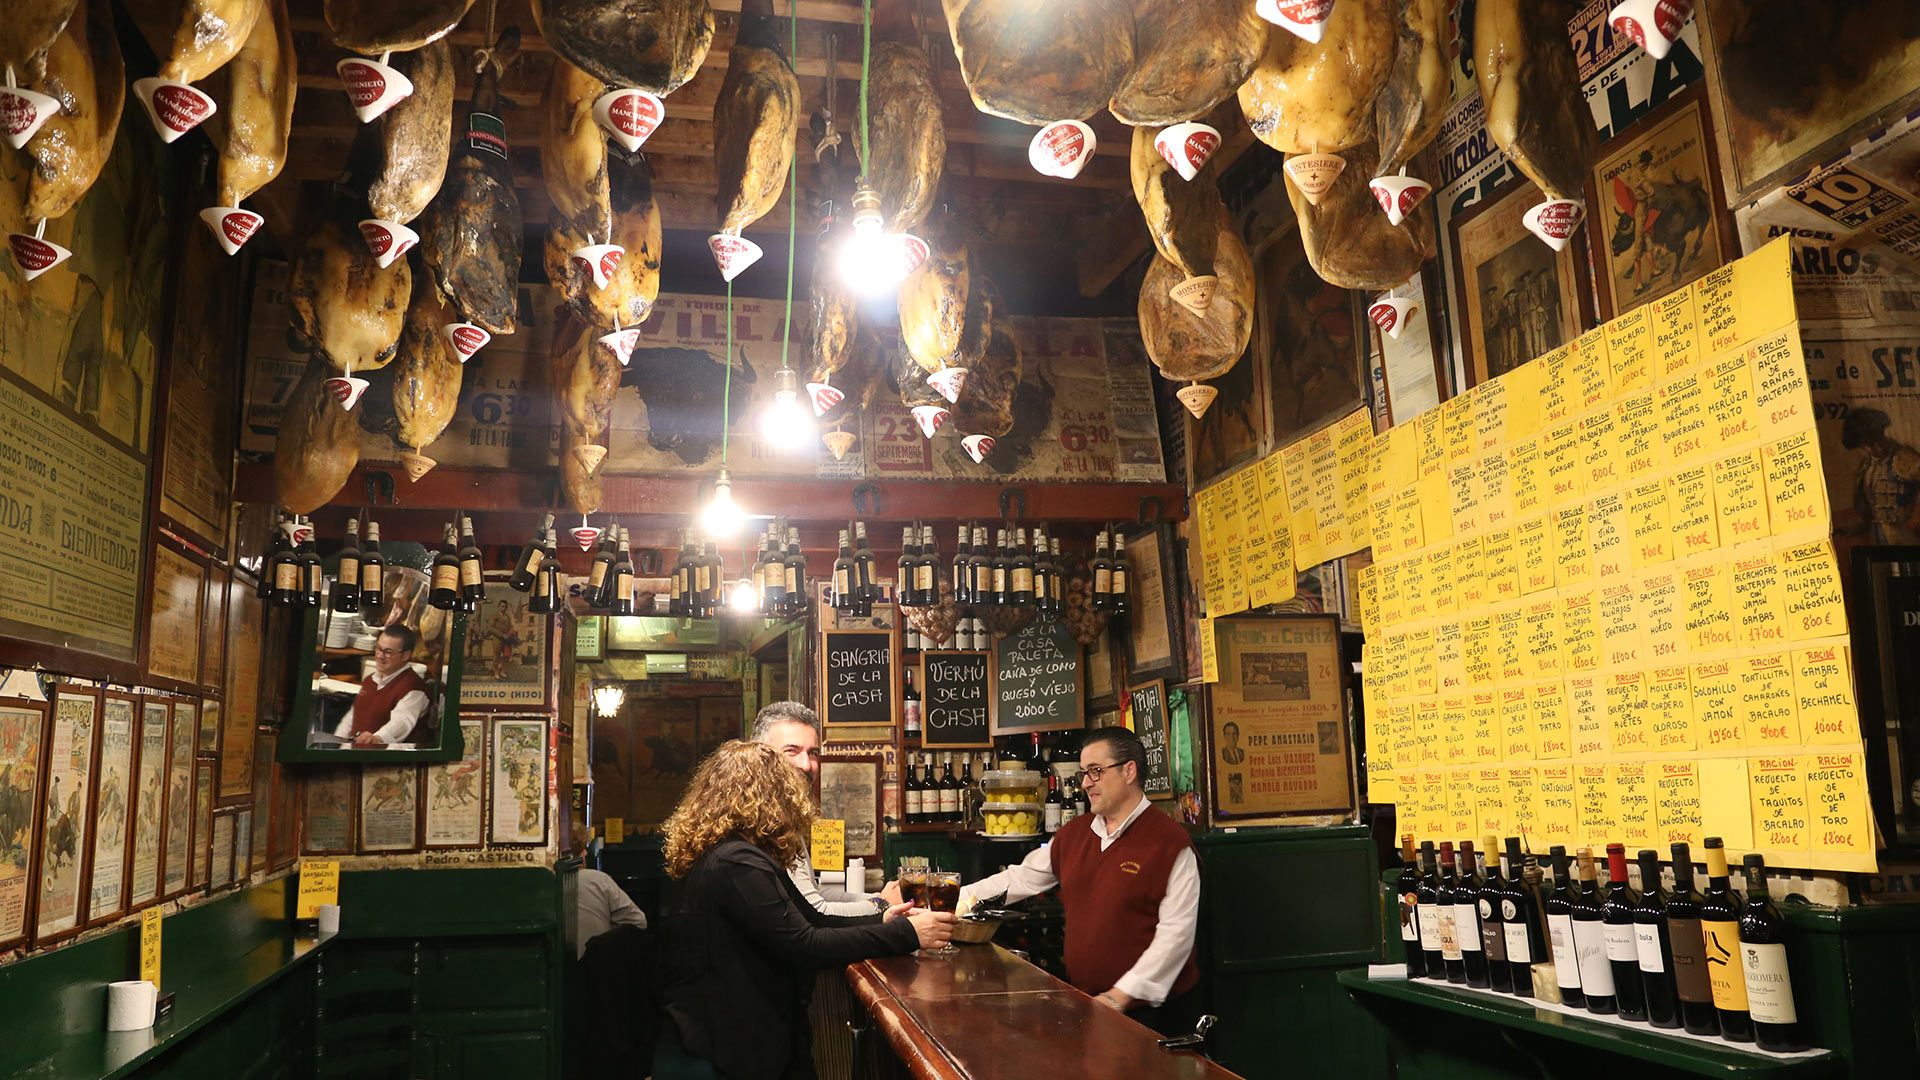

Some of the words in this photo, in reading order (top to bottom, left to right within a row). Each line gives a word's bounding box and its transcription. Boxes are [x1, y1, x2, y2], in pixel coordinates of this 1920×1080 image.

[1570, 9, 1608, 62] 27
[1603, 160, 1632, 182] TOROS
[1801, 173, 1872, 212] 10
[1792, 246, 1880, 276] ARLOS
[1662, 289, 1689, 310] RACION
[1617, 308, 1643, 330] RACION
[1661, 307, 1682, 323] LOMO
[1669, 319, 1679, 329] DE
[1611, 326, 1646, 351] BACALAO
[1657, 322, 1694, 348] BACALAO
[1671, 338, 1681, 348] AL
[1664, 340, 1691, 361] AJILLO
[1758, 334, 1787, 354] RACION
[1613, 350, 1645, 374] TOMATE
[1716, 354, 1746, 375] RACION
[1759, 349, 1791, 371] ANCAS
[1872, 347, 1920, 389] SE
[1768, 364, 1780, 377] DE
[1713, 374, 1736, 390] LOMO
[1762, 368, 1795, 390] RANAS
[1721, 385, 1732, 398] DE
[1757, 378, 1803, 407] SALTEADAS
[1708, 391, 1749, 415] MERLUZA
[1716, 406, 1742, 423] FRITO
[878, 416, 918, 442] 23
[1663, 420, 1705, 444] BOQUERONES
[1626, 441, 1649, 458] ACEITE
[1777, 432, 1806, 452] RACION
[1725, 453, 1752, 468] RACION
[1772, 450, 1805, 469] PAPAS
[1716, 463, 1760, 484] CABRILLAS
[1770, 460, 1811, 483] ALIÑADAS
[1784, 475, 1798, 487] CON
[1728, 481, 1754, 498] JAMON
[1776, 483, 1806, 503] MELVA
[1631, 494, 1667, 514] MORCILLA
[1723, 500, 1757, 516] CHORIZO
[1635, 522, 1662, 538] ARROZ
[1557, 549, 1587, 565] CHORIZO
[1792, 544, 1822, 559] RACION
[1734, 565, 1777, 582] ALCACHOFAS
[1688, 580, 1710, 592] PISTO
[1735, 578, 1776, 593] SALTEADAS
[1787, 575, 1833, 593] ALIÑADOS
[1743, 597, 1768, 610] JAMON
[1788, 594, 1842, 613] LANGOSTINOS
[1742, 612, 1775, 625] GAMBAS
[1018, 627, 1035, 637] DE
[1039, 625, 1056, 636] LA
[1018, 638, 1055, 651] CASA
[830, 648, 890, 668] SANGRIA
[1007, 648, 1064, 663] PALETA
[1806, 650, 1836, 661] RACION
[838, 672, 857, 686] DE
[862, 670, 881, 682] LA
[929, 657, 984, 683] VERMÚ
[999, 665, 1028, 681] CAÑA
[1029, 665, 1043, 677] DE
[1046, 662, 1076, 674] LOMO
[1741, 669, 1790, 684] TORTILLITAS
[1801, 665, 1839, 676] GAMBAS
[511, 689, 542, 700] (HIJO)
[832, 689, 882, 707] CASA
[933, 687, 958, 703] DE
[961, 686, 980, 699] LA
[1002, 688, 1036, 701] QUESO
[1040, 680, 1075, 697] VIEJO
[1693, 684, 1737, 698] SOLOMILLO
[1743, 691, 1790, 703] CAMARONES
[1533, 696, 1562, 710] CAZUELA
[1800, 693, 1851, 710] BECHAMEL
[929, 708, 985, 729] CASA
[1702, 707, 1734, 722] JAMON
[1748, 708, 1790, 723] BACALAO
[1248, 735, 1268, 747] PEPE
[1818, 755, 1852, 766] RACION
[1754, 774, 1796, 784] REVUELTO
[1807, 769, 1854, 781] REVUELTO
[1251, 781, 1280, 793] MANOLO
[1475, 784, 1500, 794] CHOCOS
[1760, 796, 1803, 808] TAQUITOS
[1821, 793, 1846, 803] COLA
[1763, 819, 1805, 832] BACALAO
[1821, 815, 1848, 826] TORO
[425, 854, 460, 864] Pedro
[467, 852, 534, 863] CASTILLO
